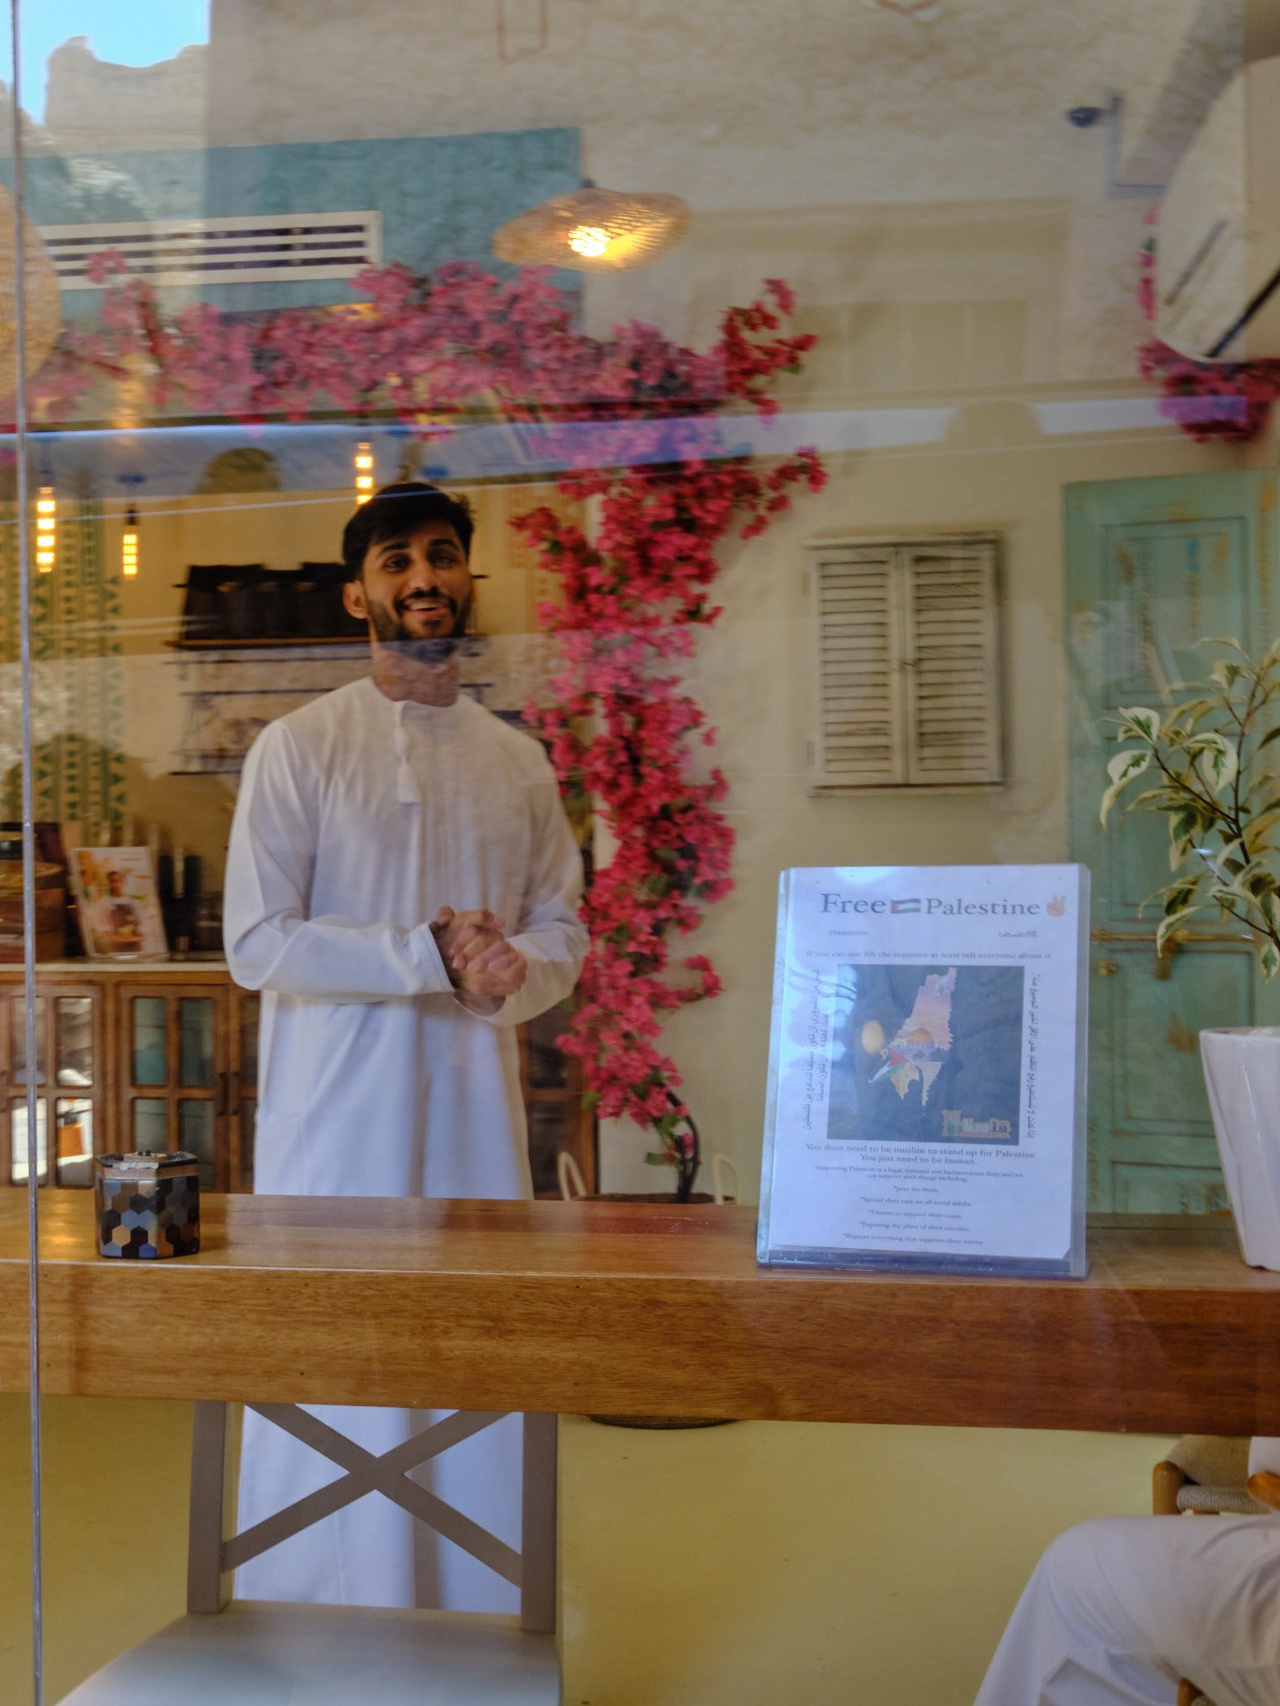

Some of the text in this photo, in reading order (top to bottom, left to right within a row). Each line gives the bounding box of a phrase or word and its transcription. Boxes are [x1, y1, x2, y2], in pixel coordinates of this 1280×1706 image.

[819, 893, 1041, 916] Free Palestine
[806, 1143, 821, 1151] You
[823, 1144, 843, 1152] dont
[846, 1144, 867, 1152] need
[893, 1146, 926, 1154] muslim
[939, 1148, 964, 1156] stand
[980, 1149, 993, 1157] for
[995, 1150, 1036, 1159] Palestine
[896, 1155, 918, 1163] need
[944, 1157, 977, 1165] human.
